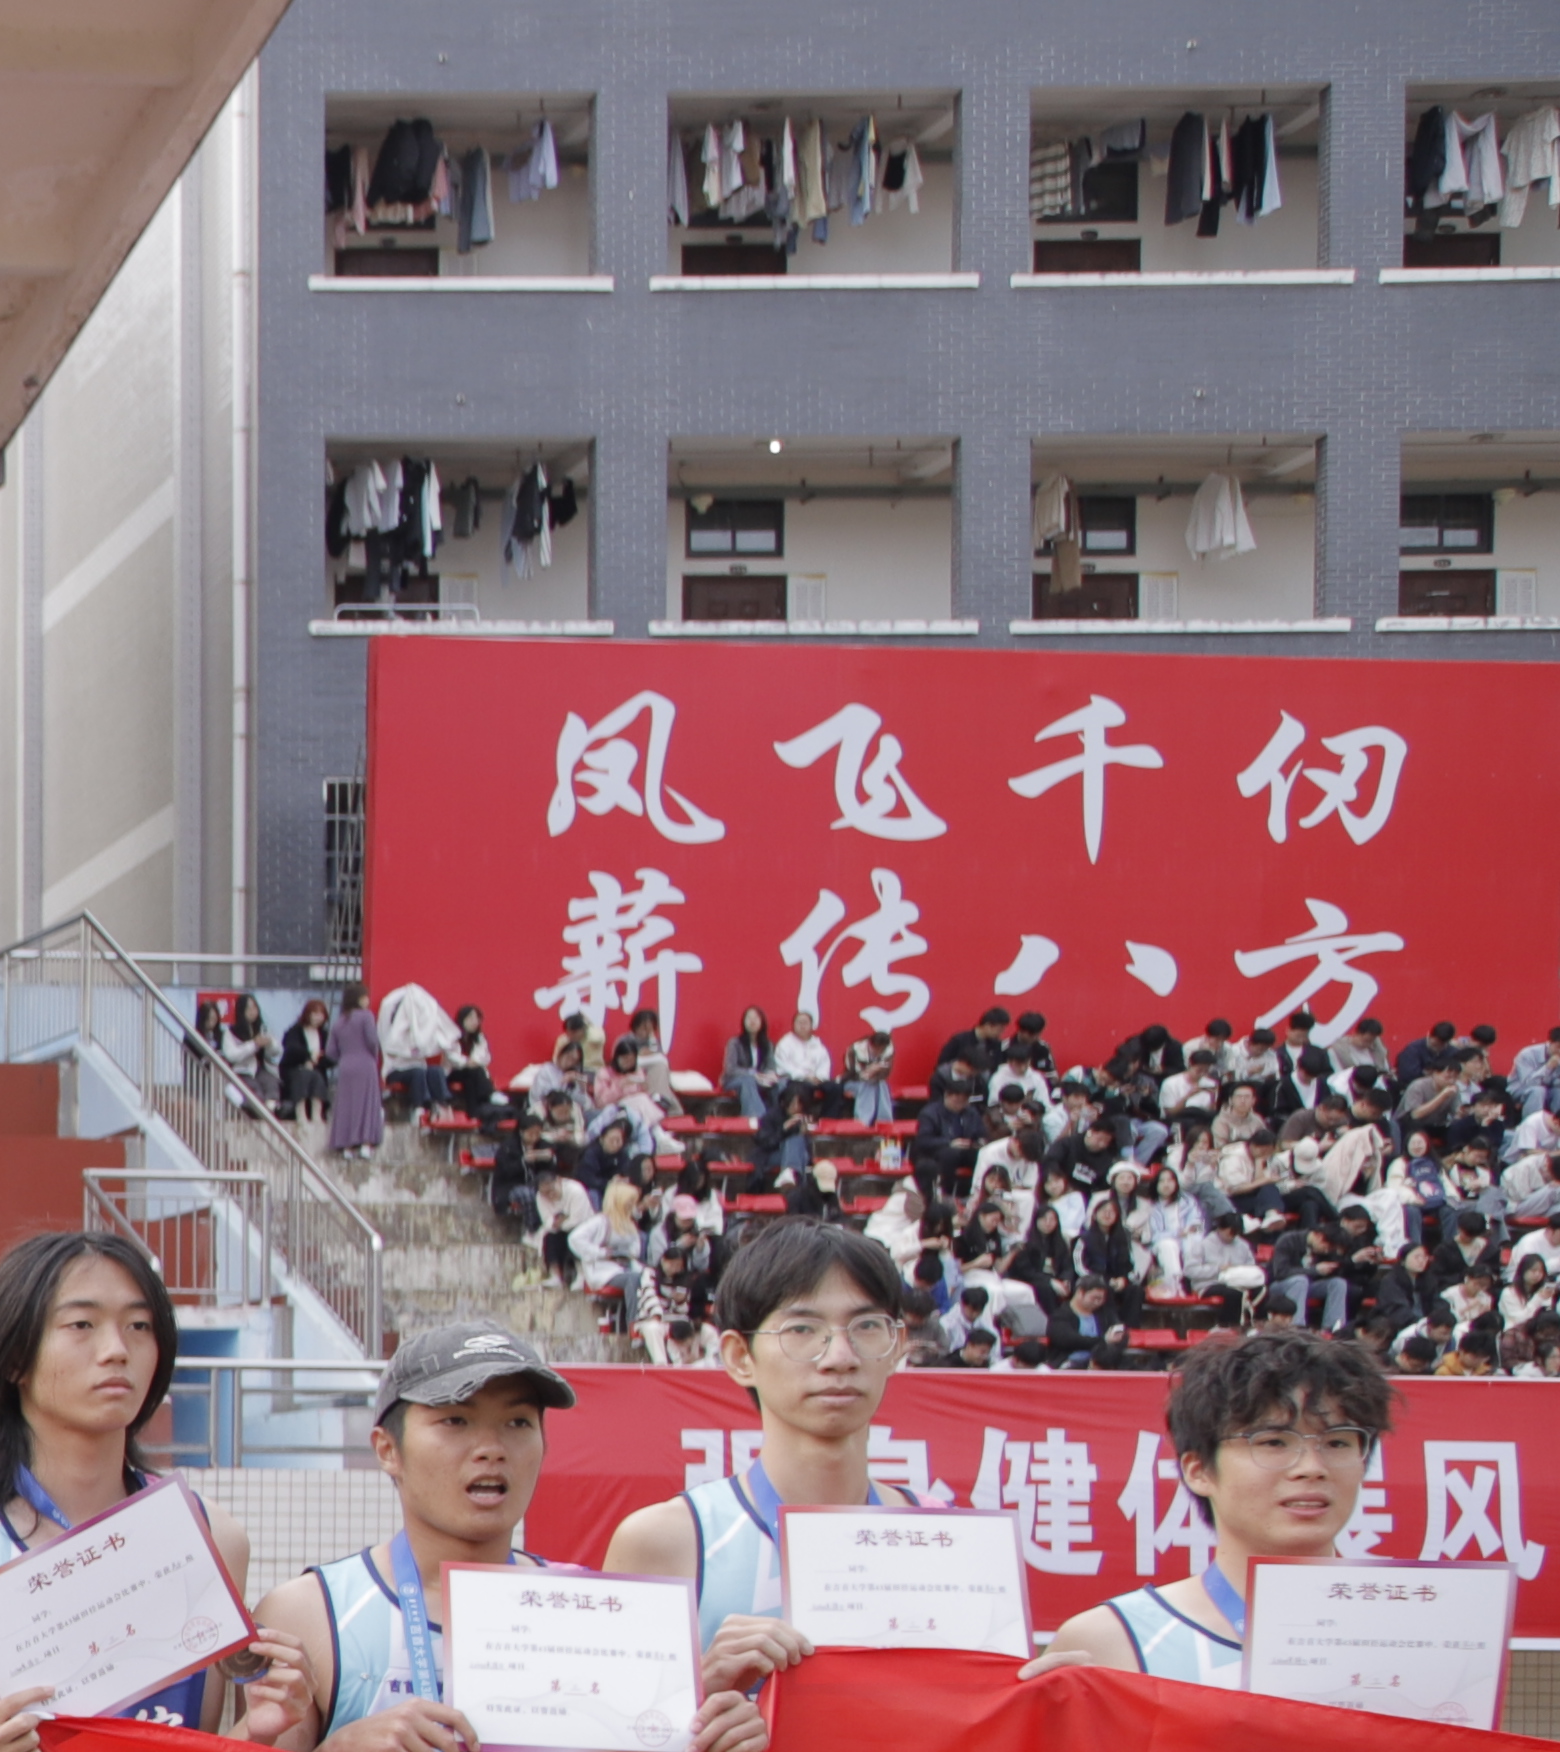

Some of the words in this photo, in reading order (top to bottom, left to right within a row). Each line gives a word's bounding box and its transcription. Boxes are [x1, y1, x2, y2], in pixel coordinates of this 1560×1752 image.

[546, 690, 1408, 864] 凤飞千仞
[681, 1427, 1545, 1580] 健体风
[855, 1529, 953, 1547] 荣誉证书
[28, 1532, 126, 1594] 荣誉证书
[519, 1590, 623, 1613] 荣誉证书
[1327, 1583, 1438, 1602] 荣誉证书
